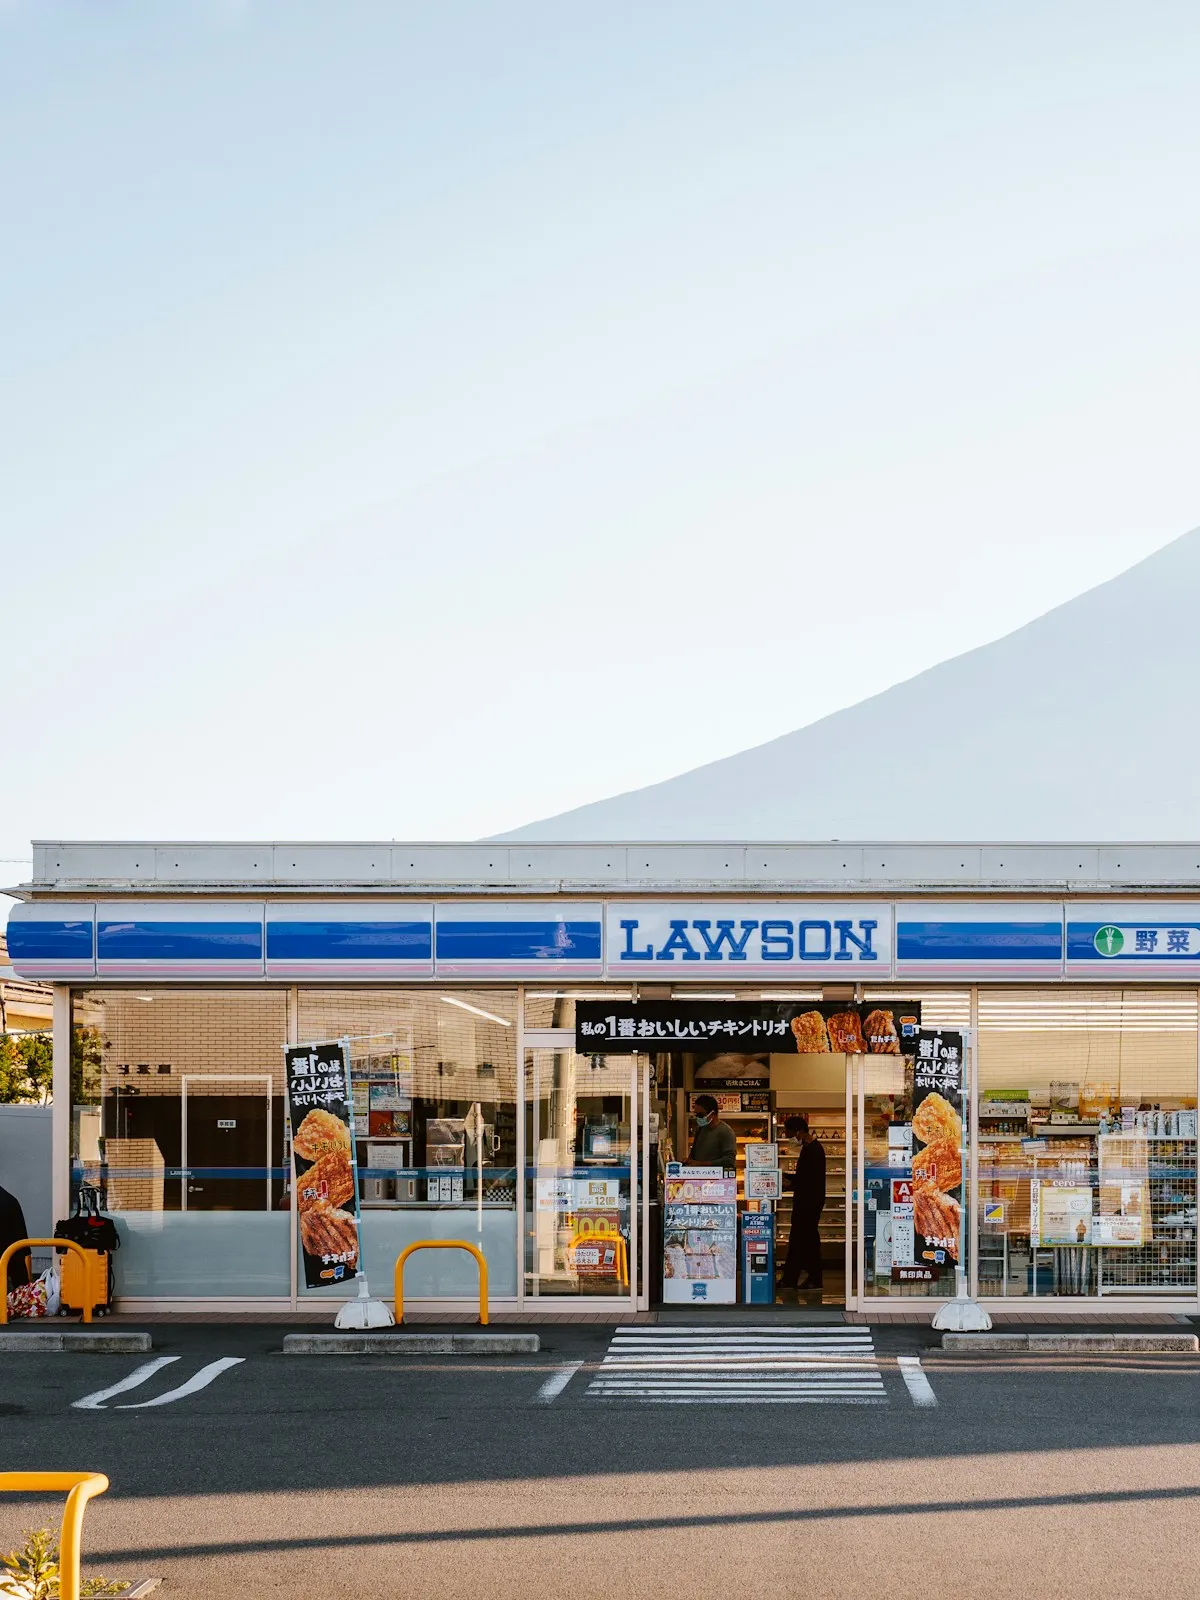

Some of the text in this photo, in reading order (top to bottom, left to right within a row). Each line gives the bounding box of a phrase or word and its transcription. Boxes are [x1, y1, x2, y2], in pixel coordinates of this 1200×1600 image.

[620, 920, 877, 960] LAWSON
[1135, 930, 1190, 952] 野菜
[581, 1016, 789, 1038] 私の1番おいしいチキントリオ
[900, 1271, 932, 1279] 無印良品
